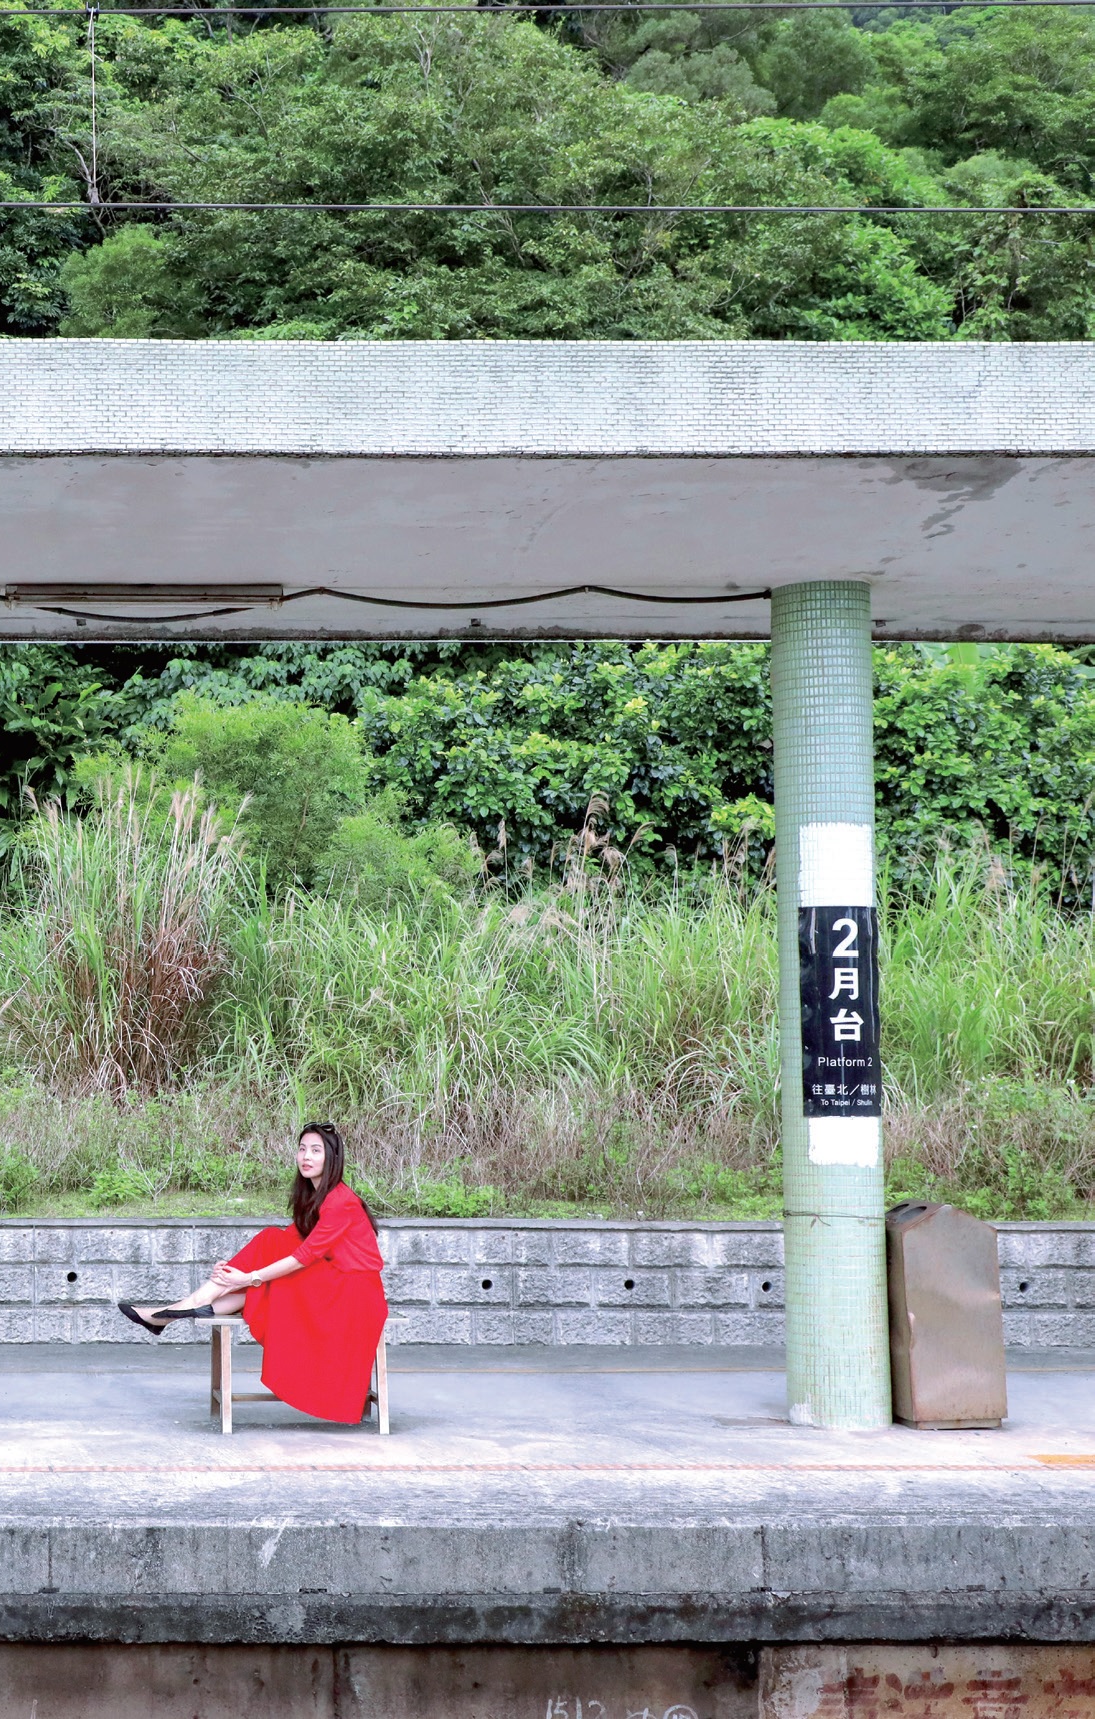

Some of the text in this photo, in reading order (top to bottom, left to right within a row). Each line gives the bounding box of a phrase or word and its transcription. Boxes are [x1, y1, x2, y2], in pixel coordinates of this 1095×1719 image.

[828, 918, 864, 1041] 2月台
[818, 1056, 873, 1067] Platform 2
[831, 1099, 850, 1107] Taipei
